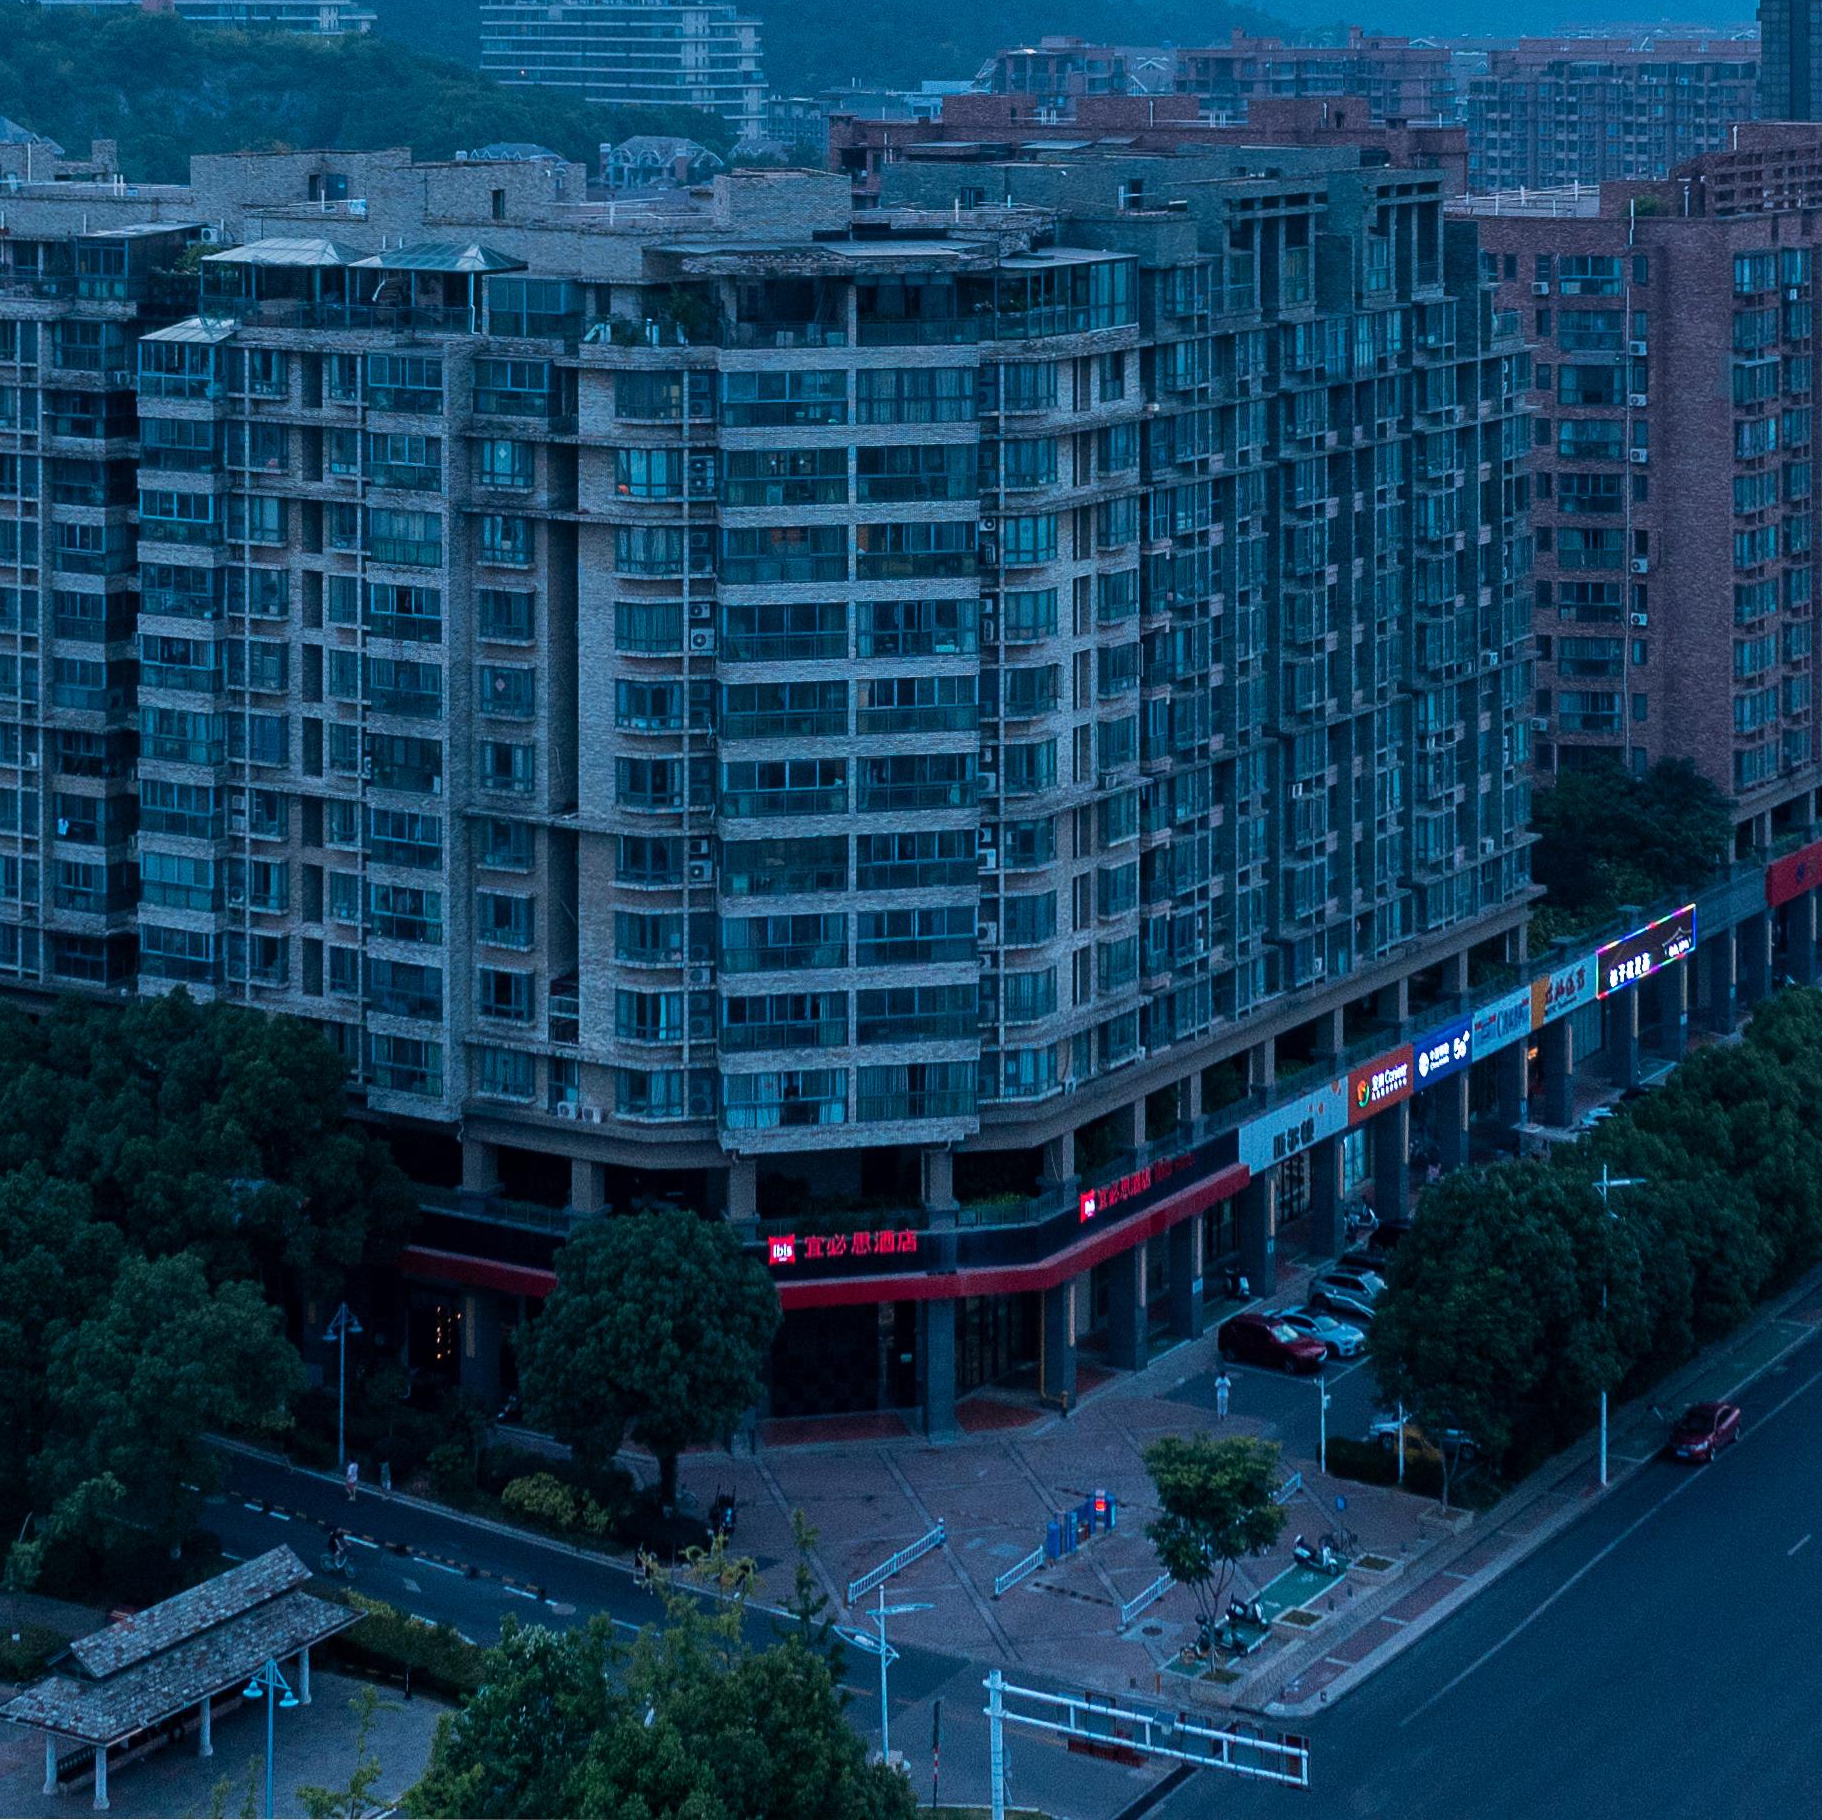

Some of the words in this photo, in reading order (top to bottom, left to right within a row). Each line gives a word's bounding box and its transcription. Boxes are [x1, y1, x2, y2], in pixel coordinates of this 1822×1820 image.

[773, 1243, 793, 1258] ibis
[804, 1229, 918, 1260] 宜必思酒店
